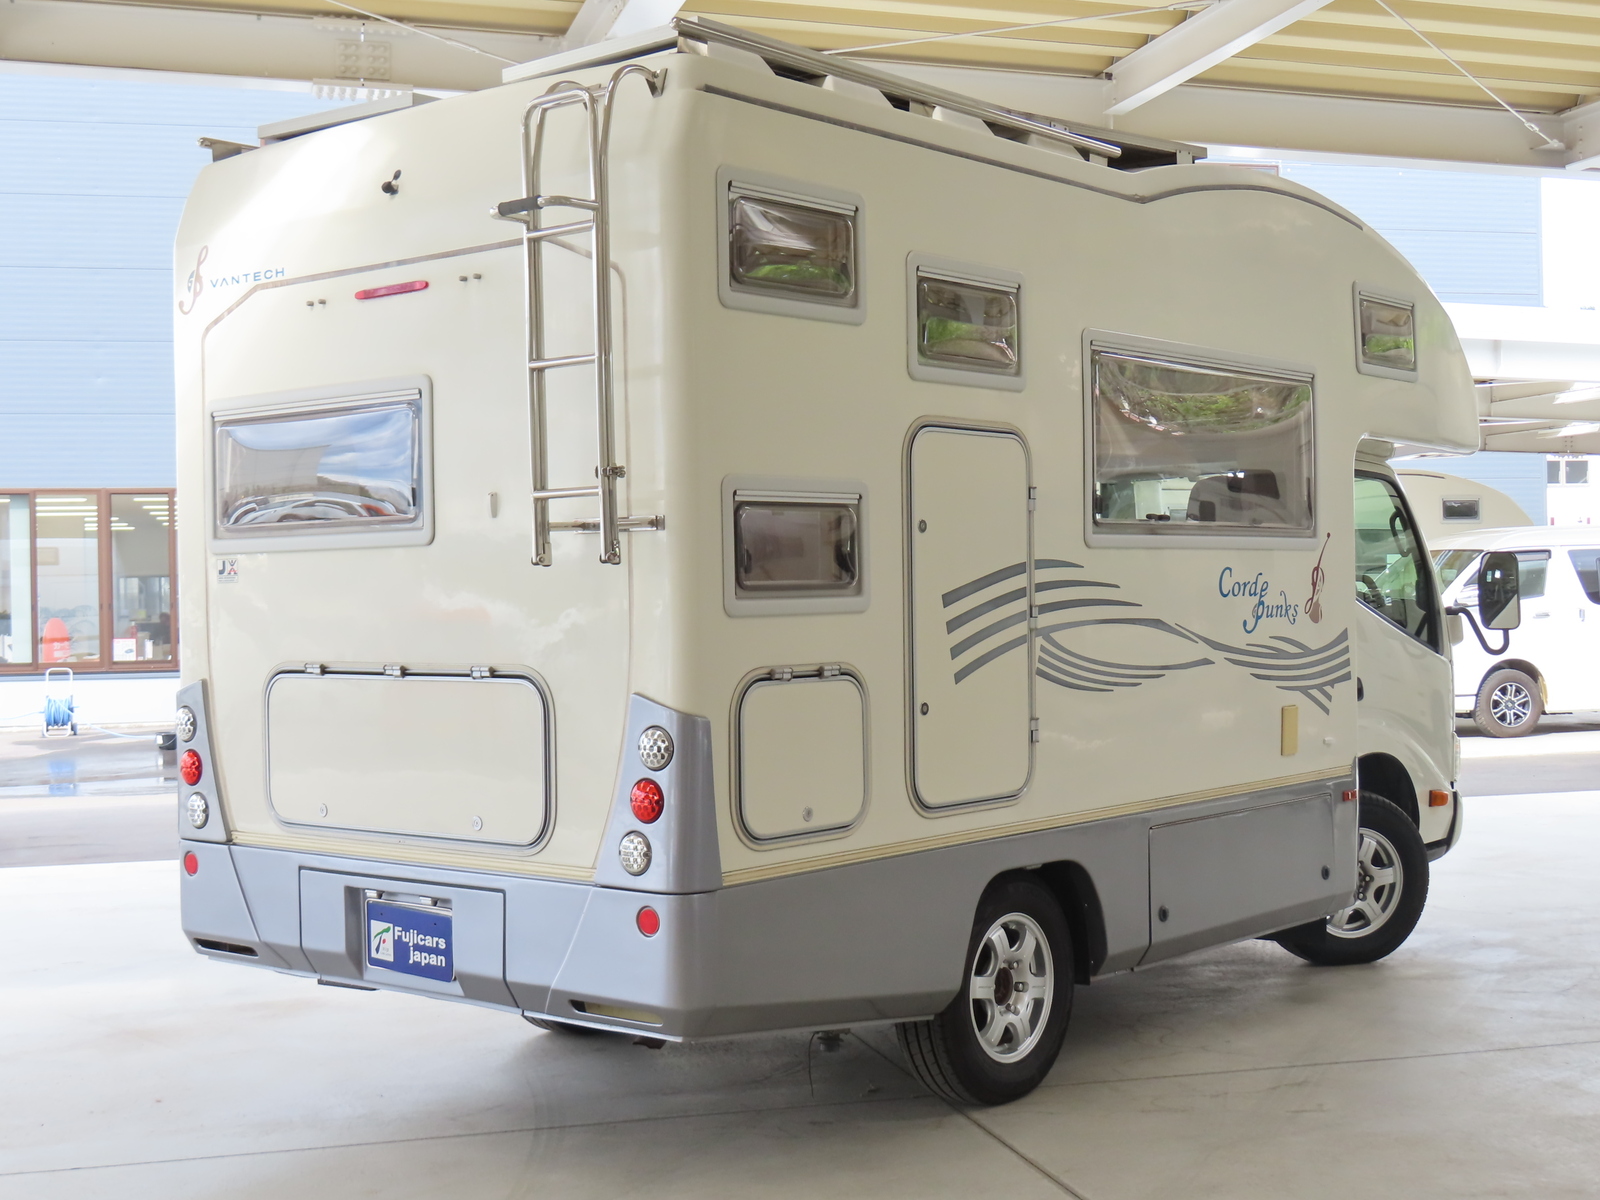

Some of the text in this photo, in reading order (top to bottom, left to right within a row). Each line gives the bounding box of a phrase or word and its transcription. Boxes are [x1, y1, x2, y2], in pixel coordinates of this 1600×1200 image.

[210, 267, 285, 288] VANTECH
[1219, 566, 1269, 598] Corde
[394, 926, 446, 949] Fujicars
[409, 947, 446, 967] japan
